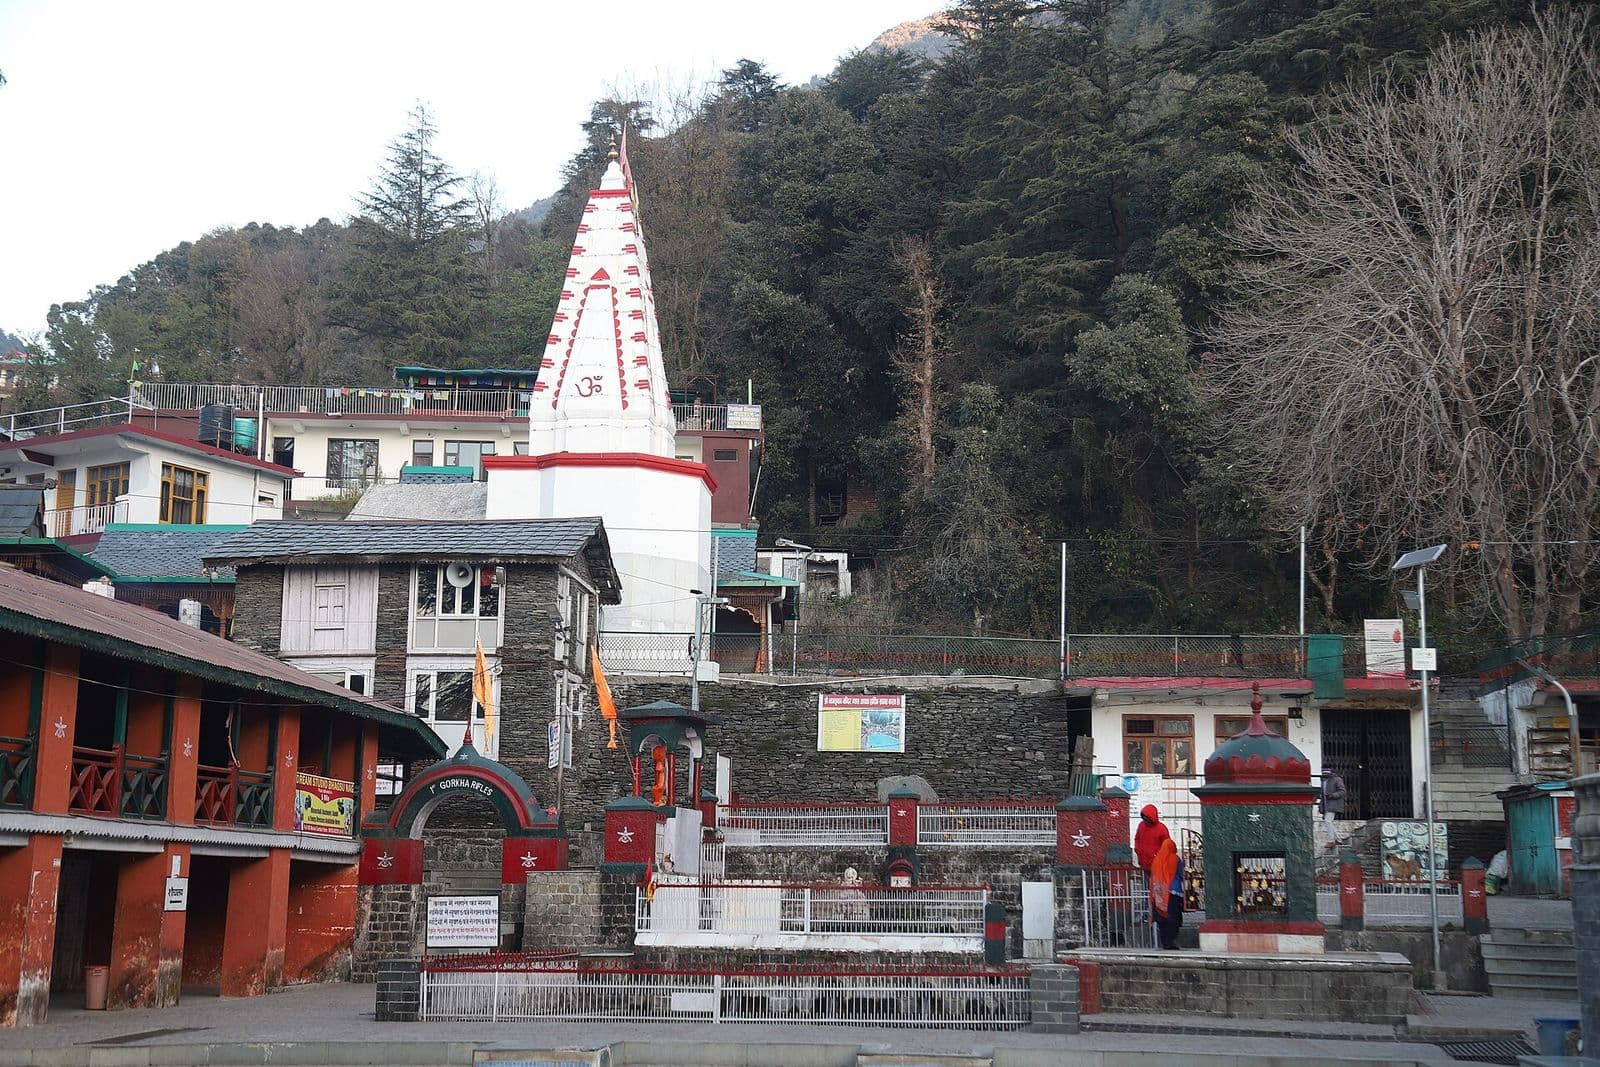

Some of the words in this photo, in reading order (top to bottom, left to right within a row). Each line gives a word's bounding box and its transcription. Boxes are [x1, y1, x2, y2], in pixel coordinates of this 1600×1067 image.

[313, 777, 329, 790] STUDIO
[440, 779, 470, 790] GORKHA
[471, 781, 493, 796] RIFLES
